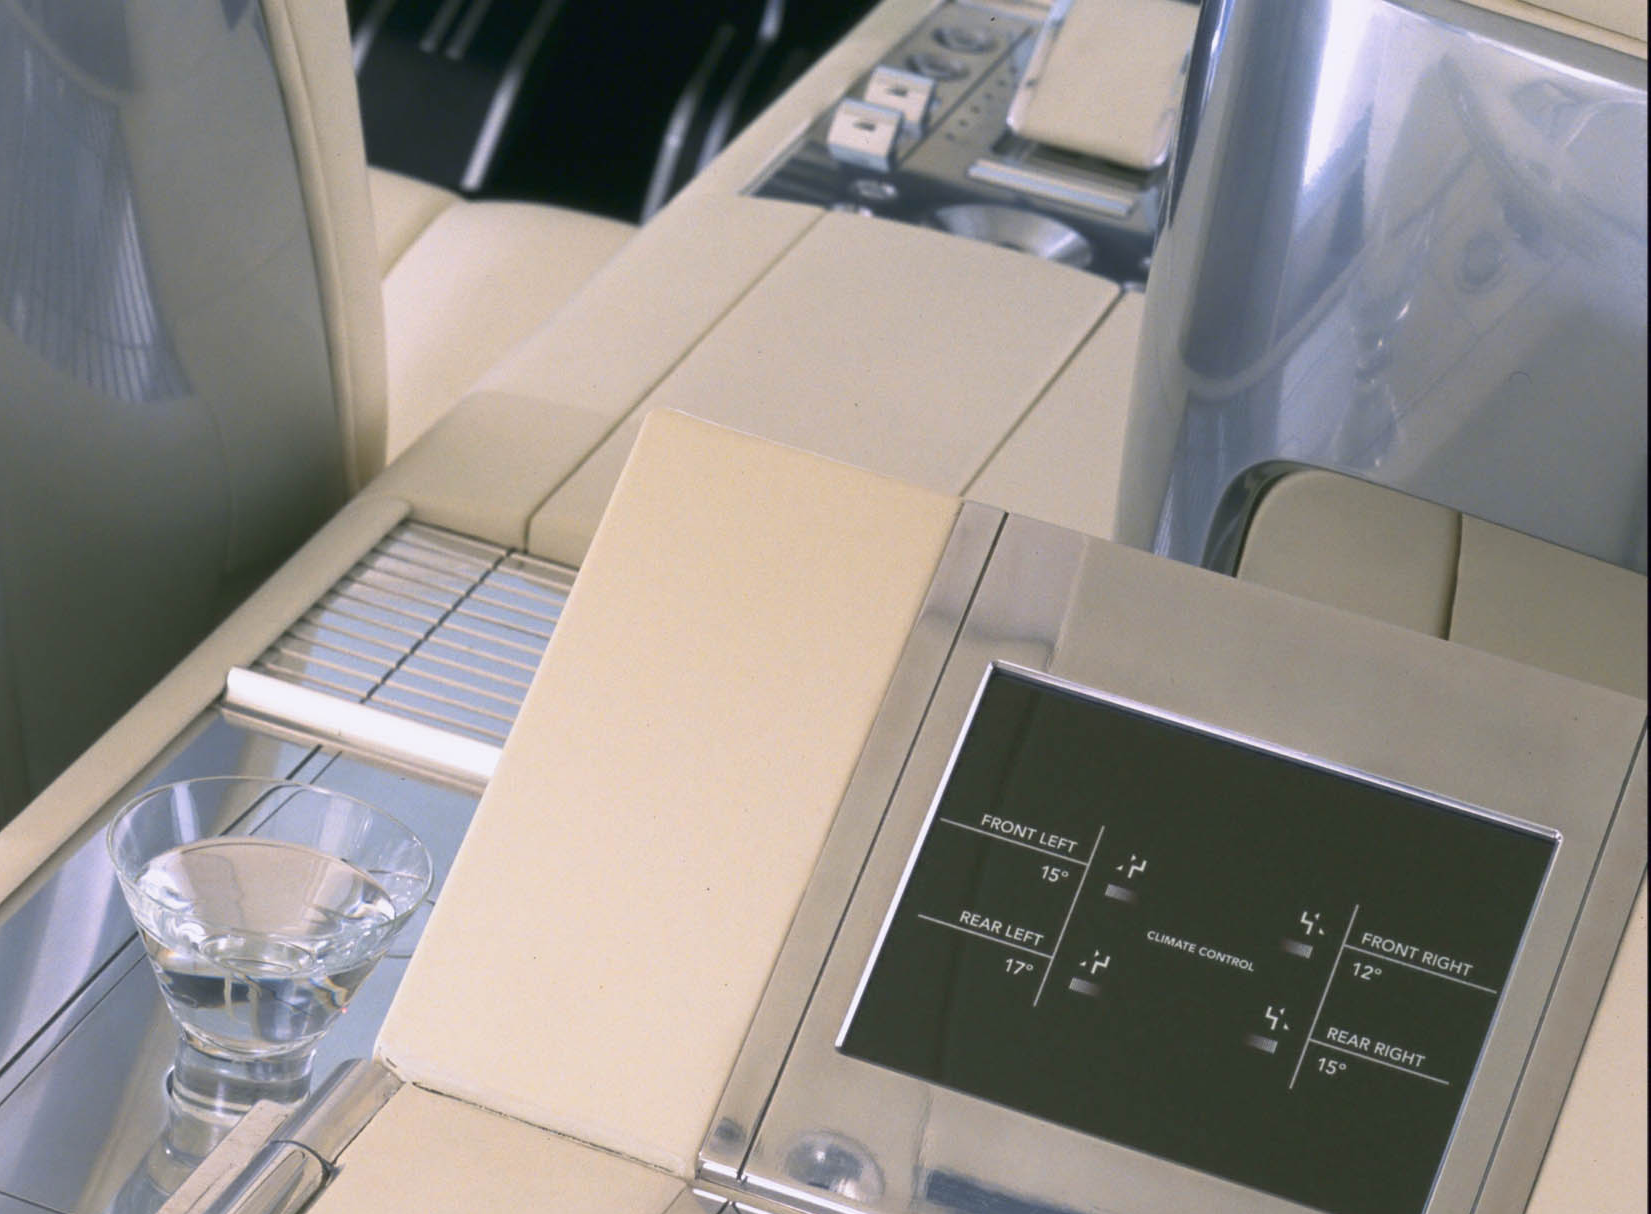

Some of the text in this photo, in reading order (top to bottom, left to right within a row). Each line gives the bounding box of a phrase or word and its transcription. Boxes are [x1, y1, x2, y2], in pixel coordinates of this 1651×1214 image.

[980, 813, 1079, 853] FRONT LEFT
[1040, 864, 1070, 883] 15°
[959, 910, 1045, 947] REAR LEFT
[1004, 957, 1034, 975] 17°
[1146, 930, 1255, 972] CLIMATE CONTROL
[1360, 932, 1474, 978] FRONT RIGHT
[1352, 961, 1383, 981] 12°
[1326, 1026, 1426, 1068] REAR RIGHT
[1316, 1056, 1347, 1076] 15°
